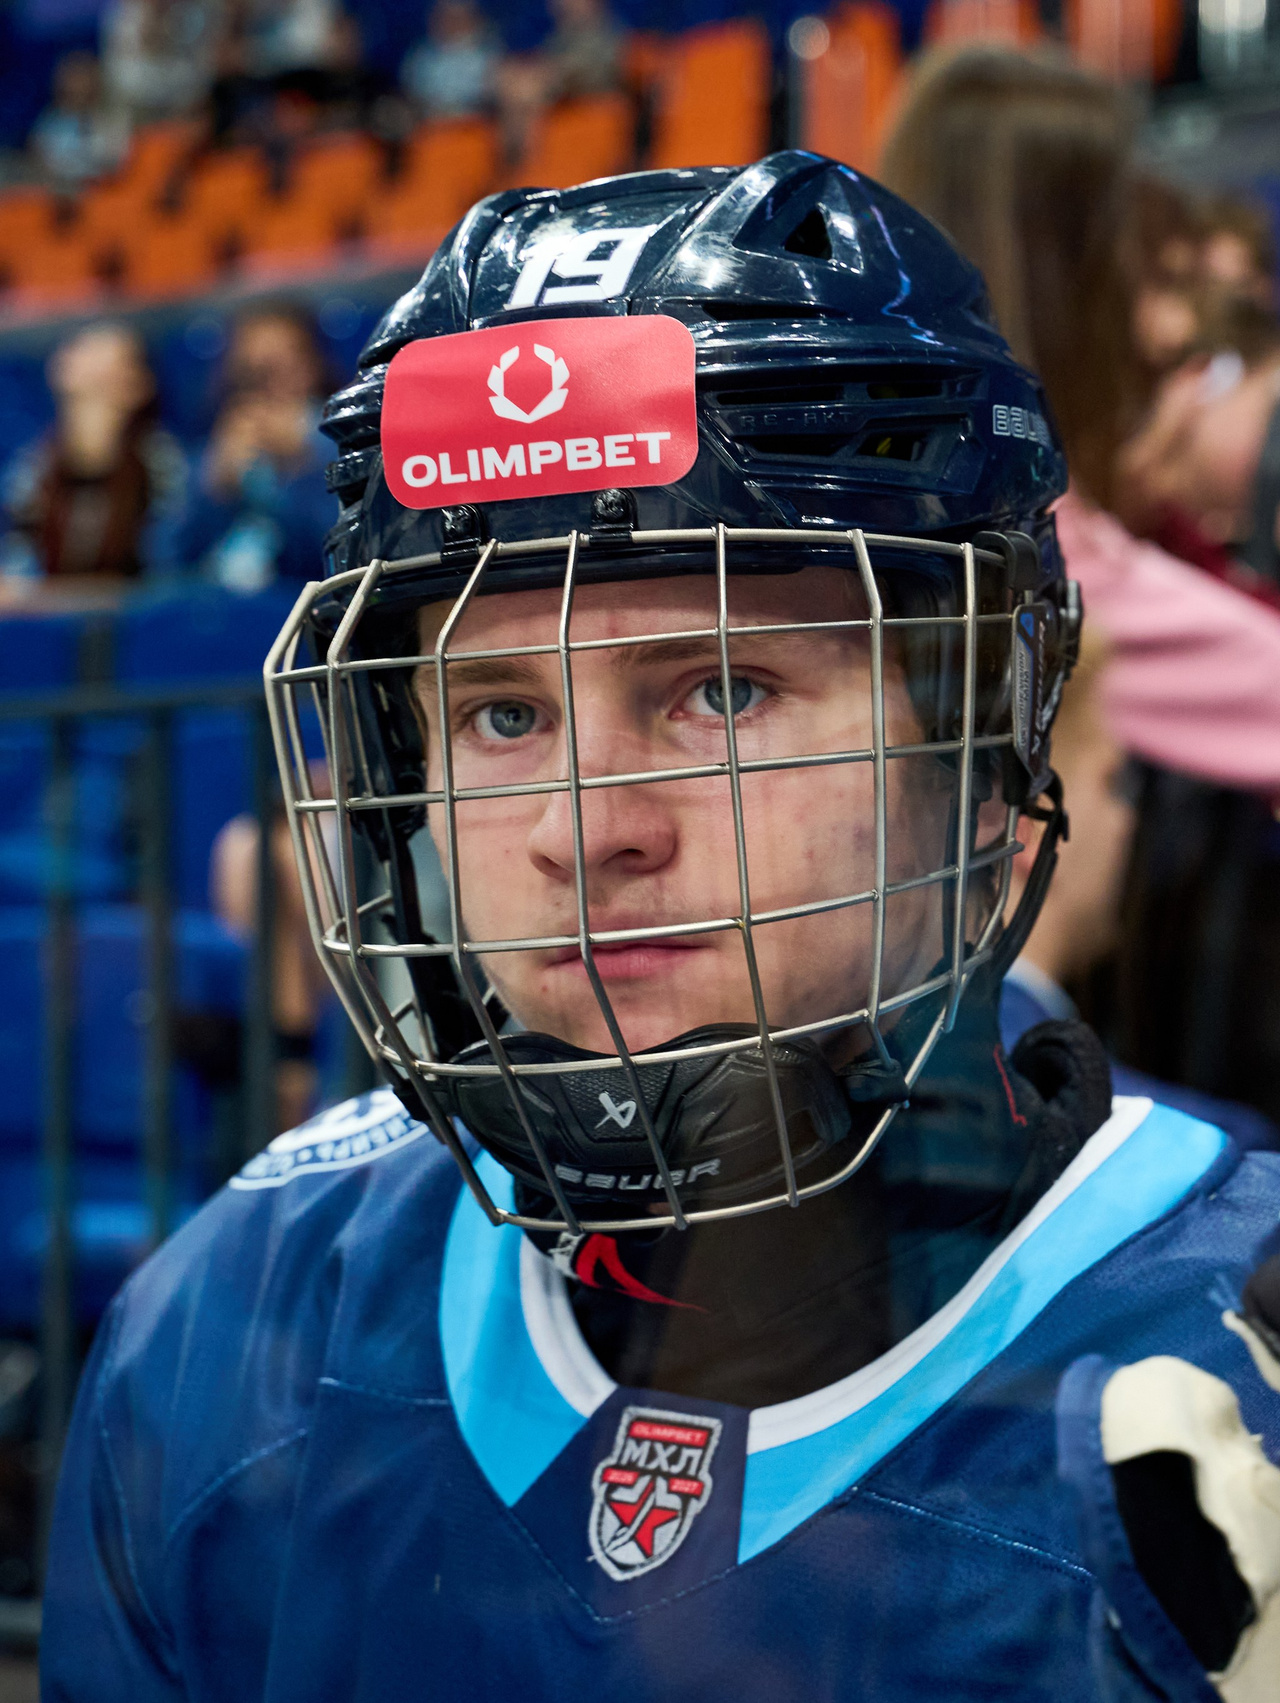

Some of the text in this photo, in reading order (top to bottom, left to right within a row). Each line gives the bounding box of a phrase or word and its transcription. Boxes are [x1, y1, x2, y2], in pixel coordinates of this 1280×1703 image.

[504, 224, 657, 310] 19
[740, 411, 852, 430] RE-AKT
[401, 431, 671, 488] OLIMPBET
[553, 1157, 722, 1191] BAUER
[633, 1424, 703, 1442] OLIMPBET
[621, 1438, 703, 1477] МХЛ
